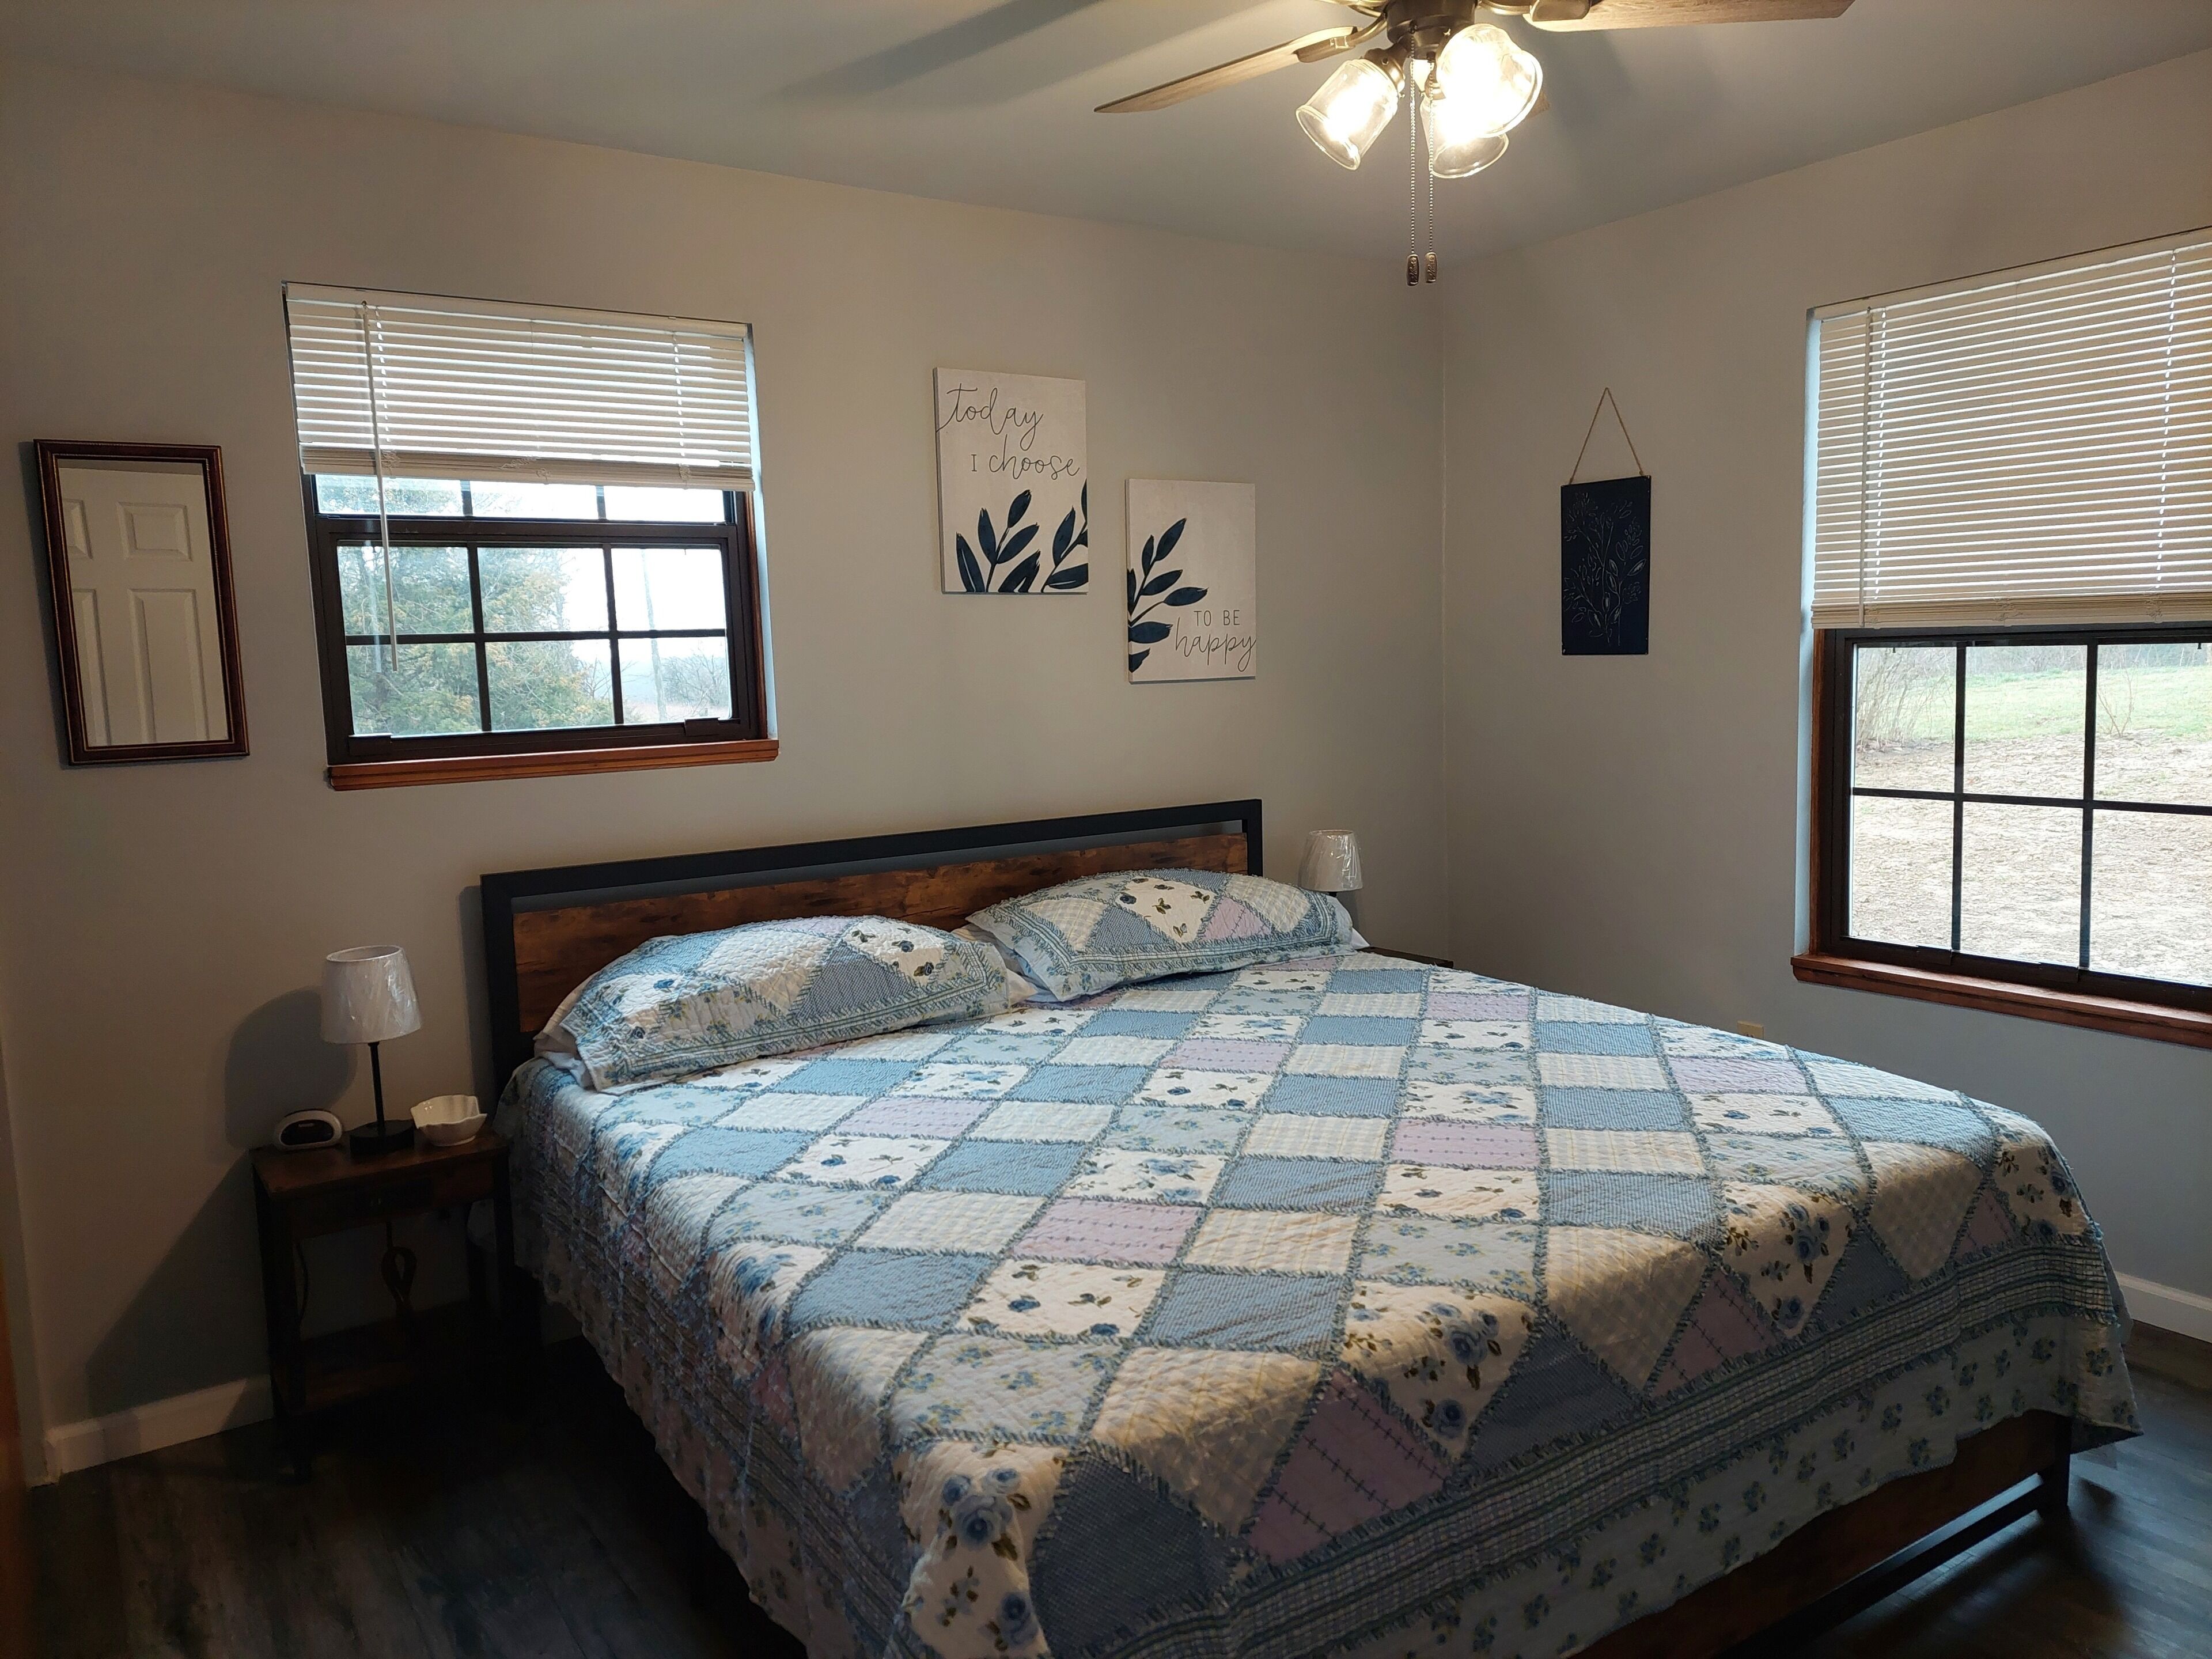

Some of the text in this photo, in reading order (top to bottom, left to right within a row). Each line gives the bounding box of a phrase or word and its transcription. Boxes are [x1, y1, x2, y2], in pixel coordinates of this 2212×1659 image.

[935, 383, 1044, 451] today
[971, 434, 1080, 480] I choose
[1194, 610, 1240, 626] TO BE
[1175, 617, 1256, 672] happy
